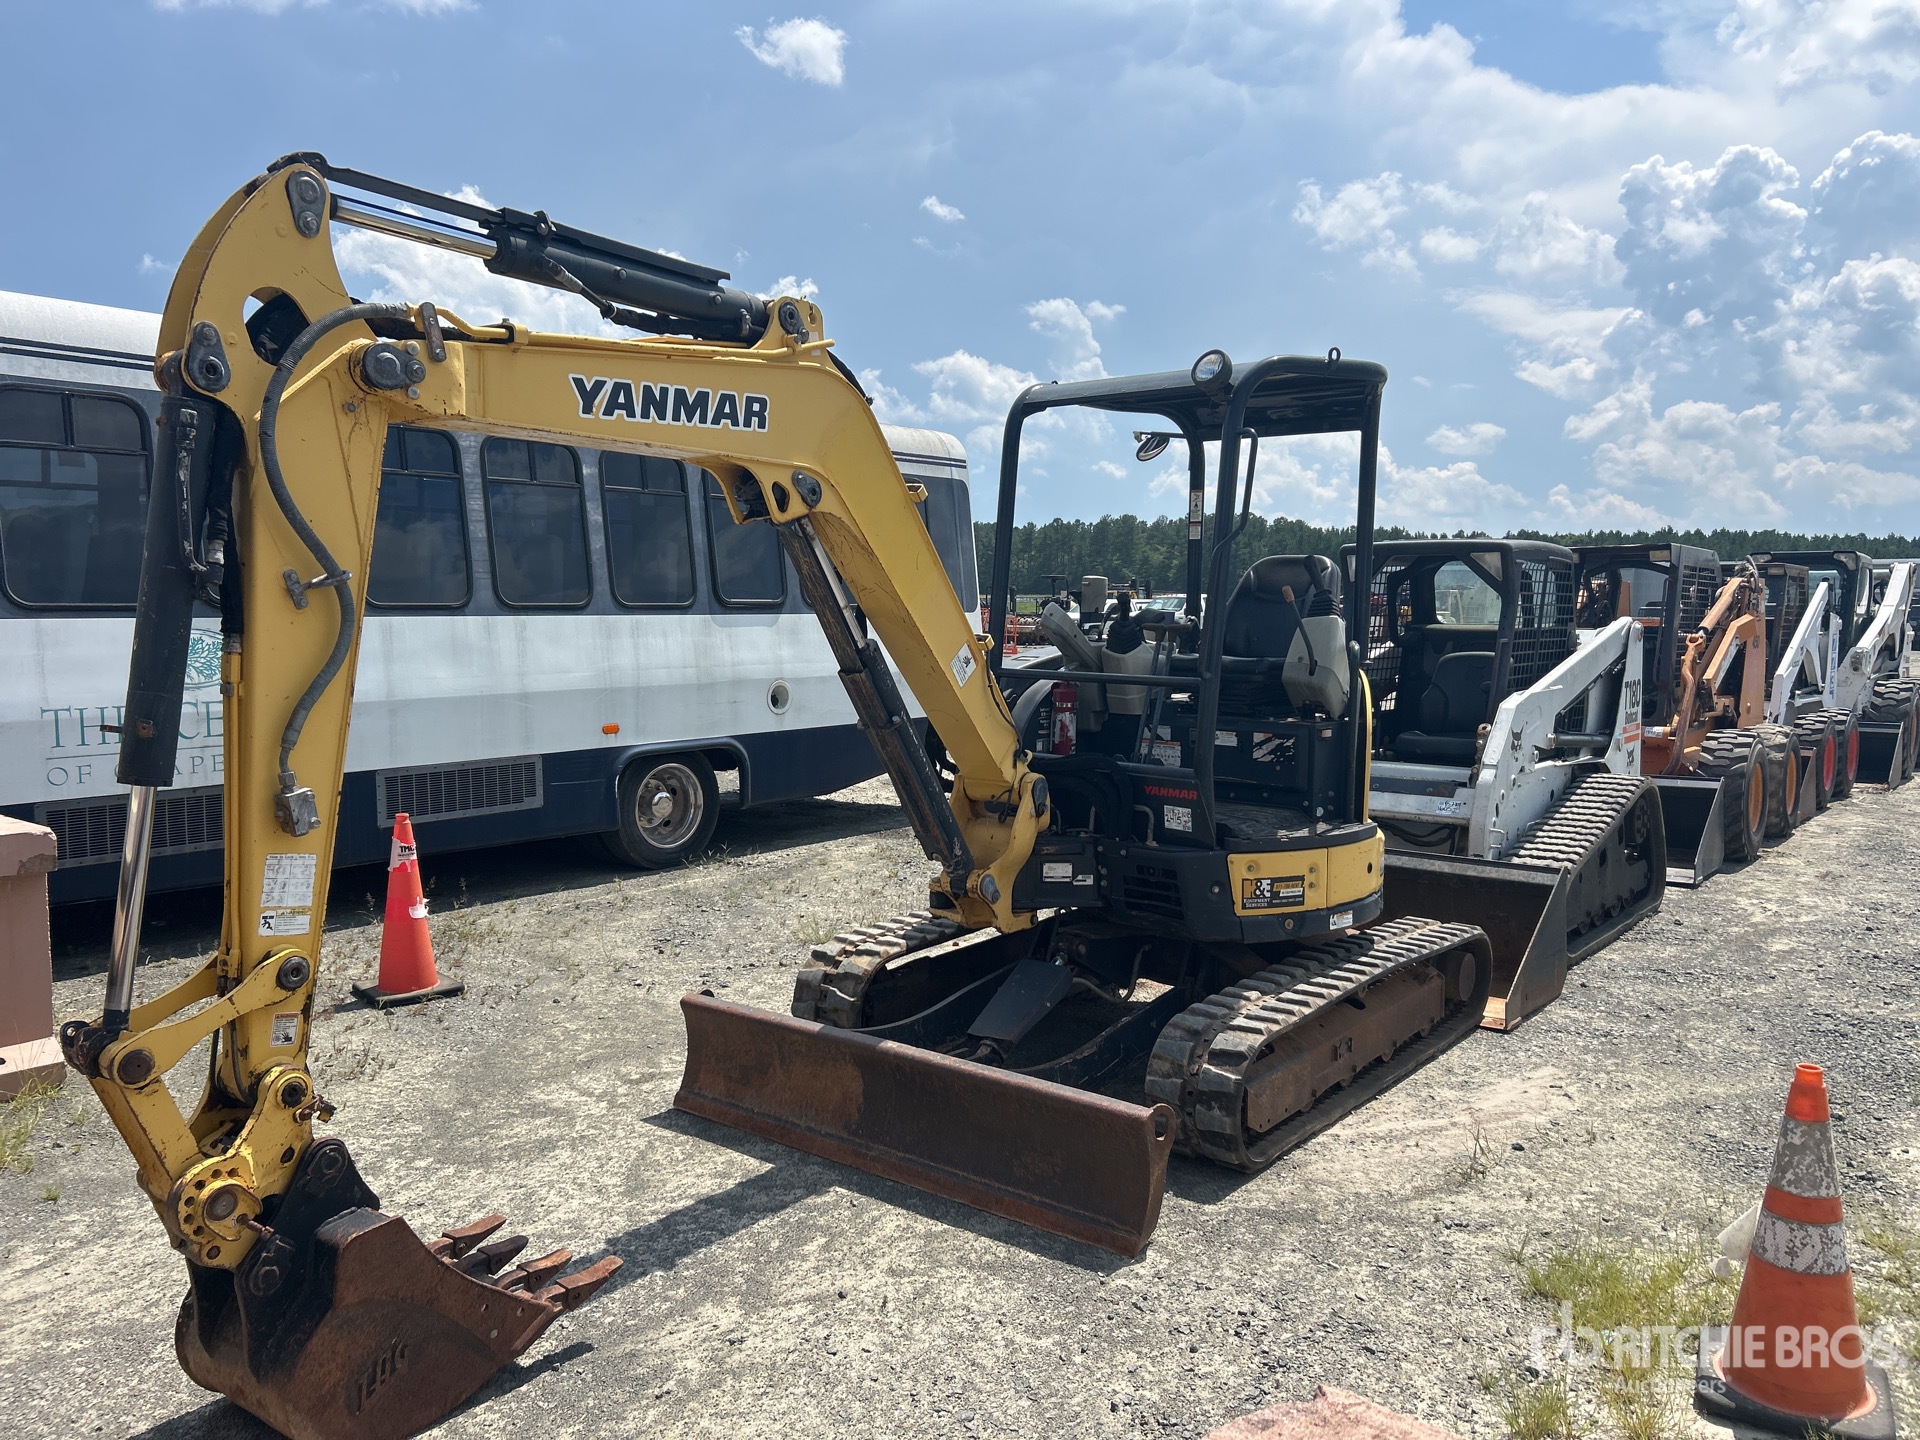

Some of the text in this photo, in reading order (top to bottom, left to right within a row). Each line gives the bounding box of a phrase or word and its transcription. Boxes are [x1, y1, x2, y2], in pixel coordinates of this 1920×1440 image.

[570, 375, 769, 431] YANMAR
[1624, 679, 1641, 711] T180
[46, 764, 92, 786] OF
[1144, 784, 1198, 801] YANMAR
[1243, 879, 1271, 899] H&E
